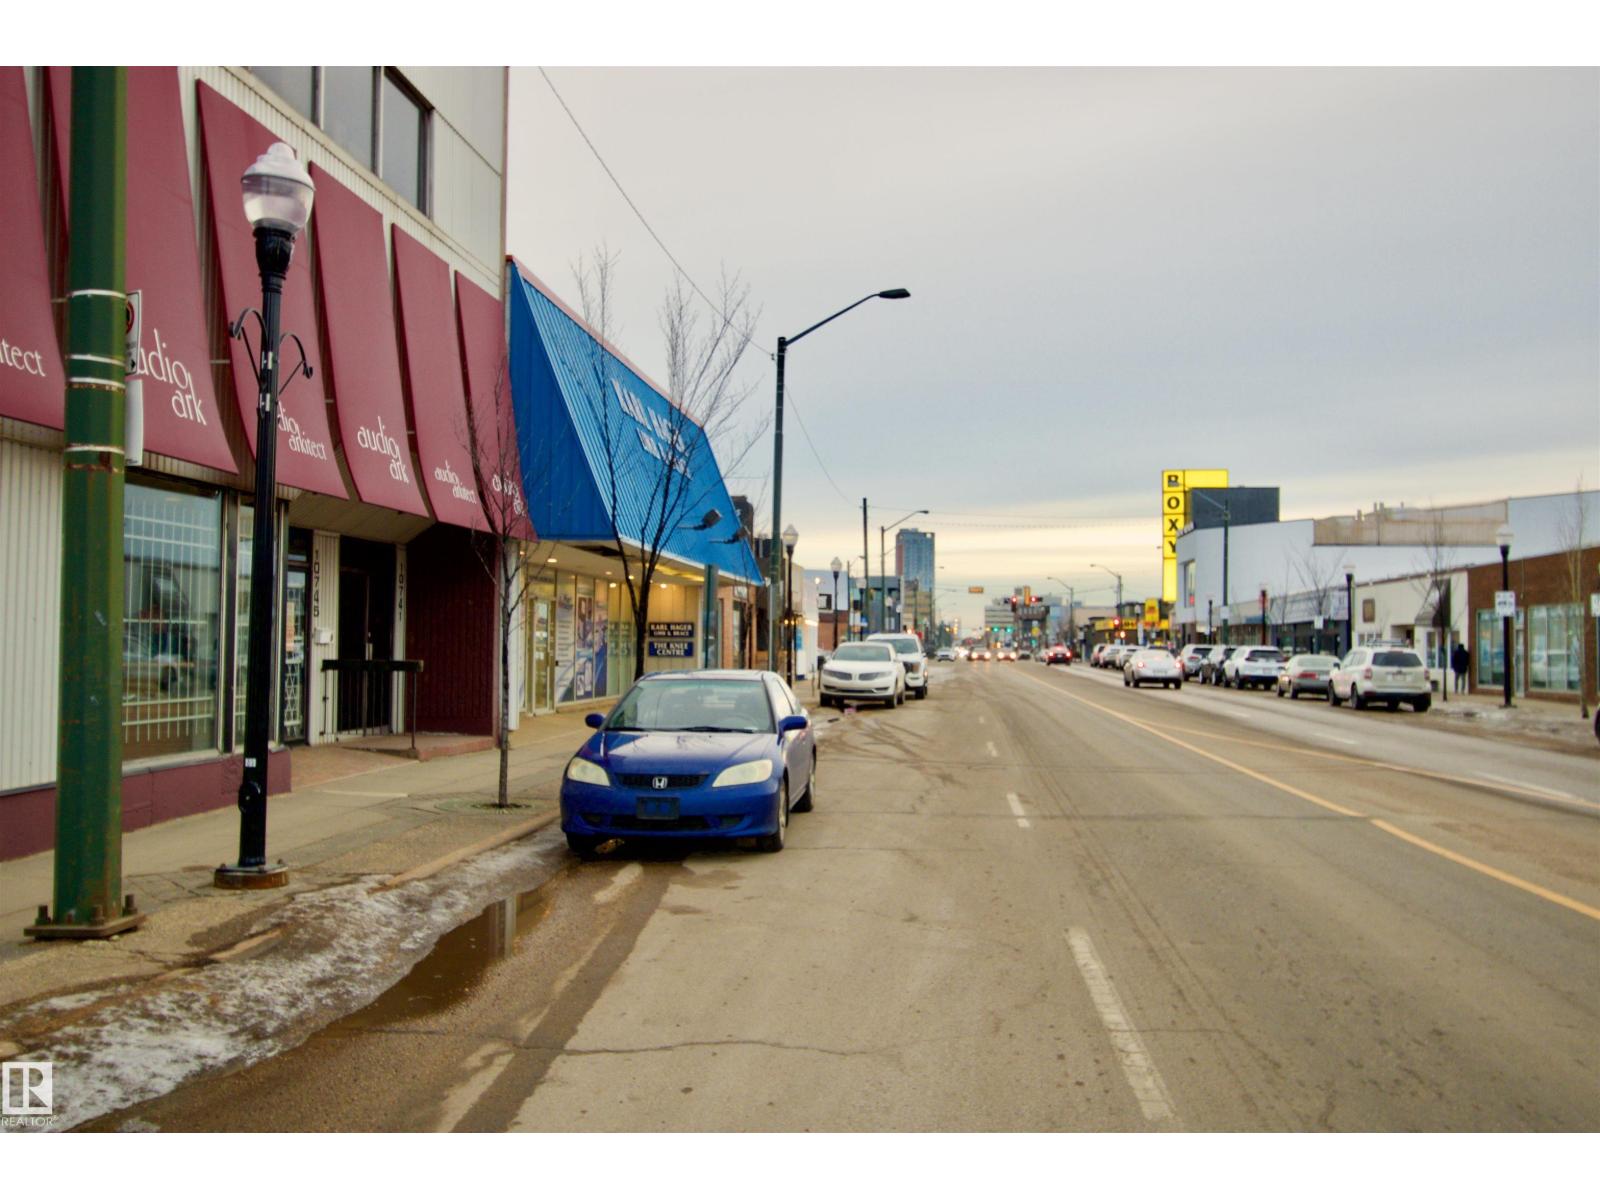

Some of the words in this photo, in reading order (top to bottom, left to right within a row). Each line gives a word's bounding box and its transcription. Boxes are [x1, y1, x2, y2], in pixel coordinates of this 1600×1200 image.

[137, 328, 188, 389] udio
[171, 372, 207, 426] ark
[277, 400, 298, 434] dio
[357, 415, 398, 460] audio
[389, 444, 410, 484] ark
[1167, 474, 1181, 554] ROXY
[669, 642, 689, 650] KNEE
